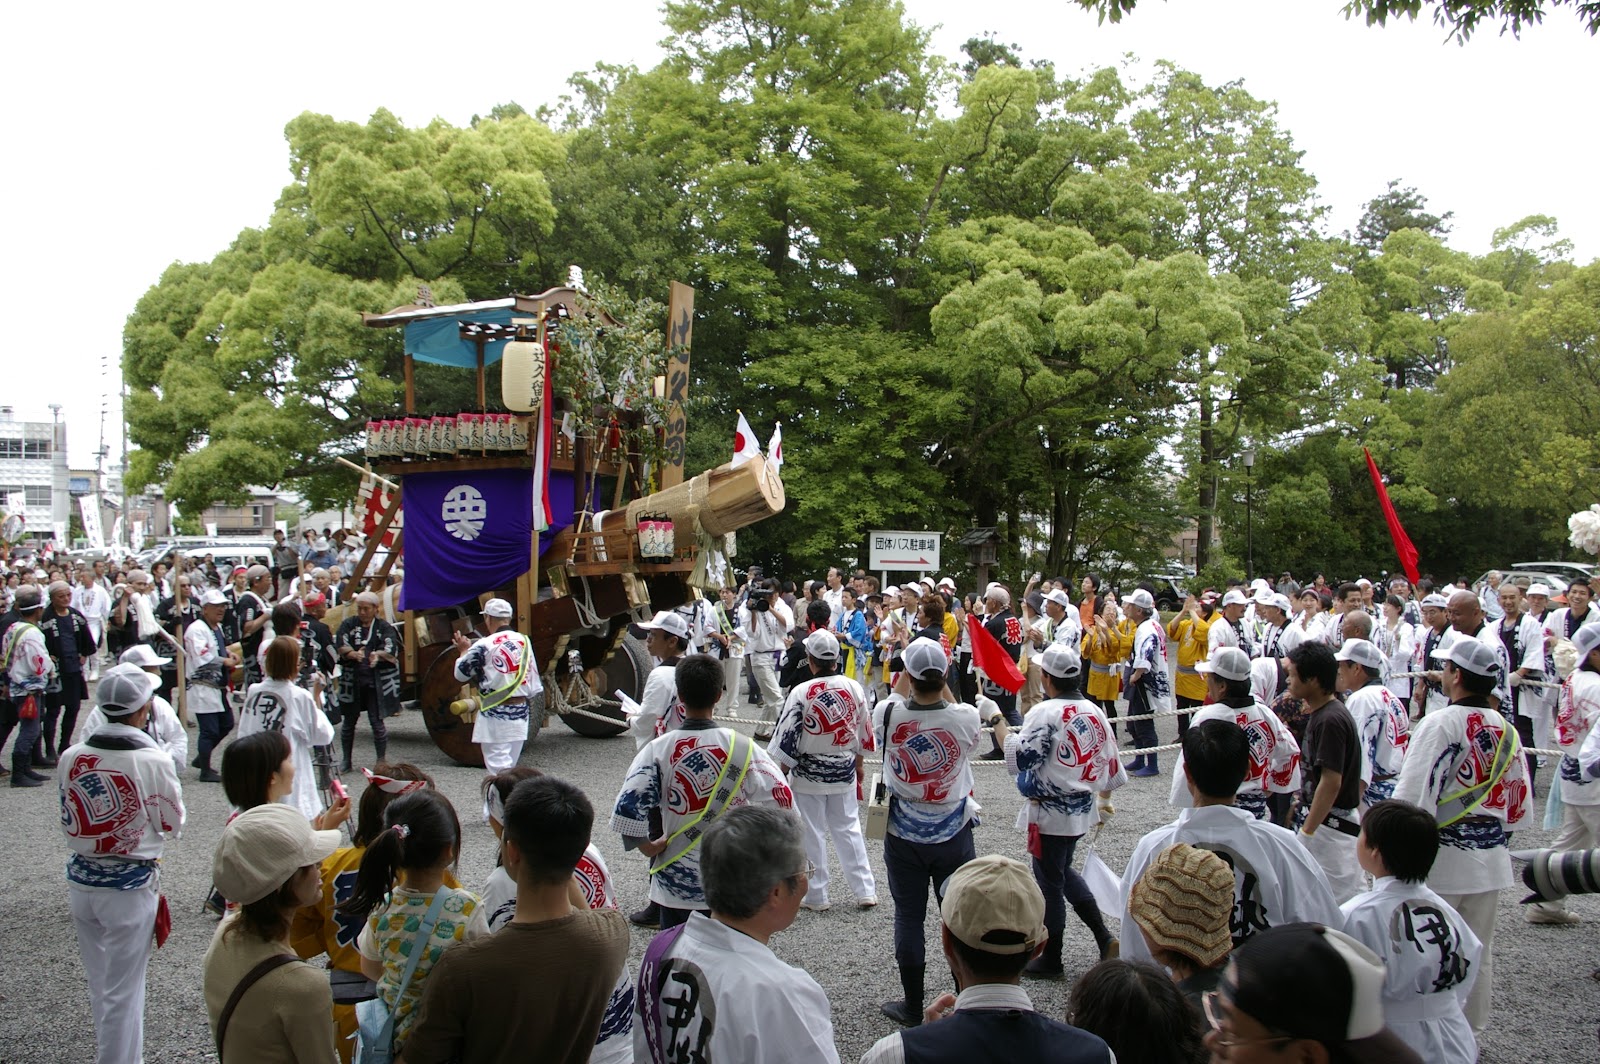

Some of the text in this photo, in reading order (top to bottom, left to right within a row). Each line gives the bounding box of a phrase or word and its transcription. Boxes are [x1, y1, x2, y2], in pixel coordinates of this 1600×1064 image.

[875, 537, 936, 551] 団体バス駐車場
